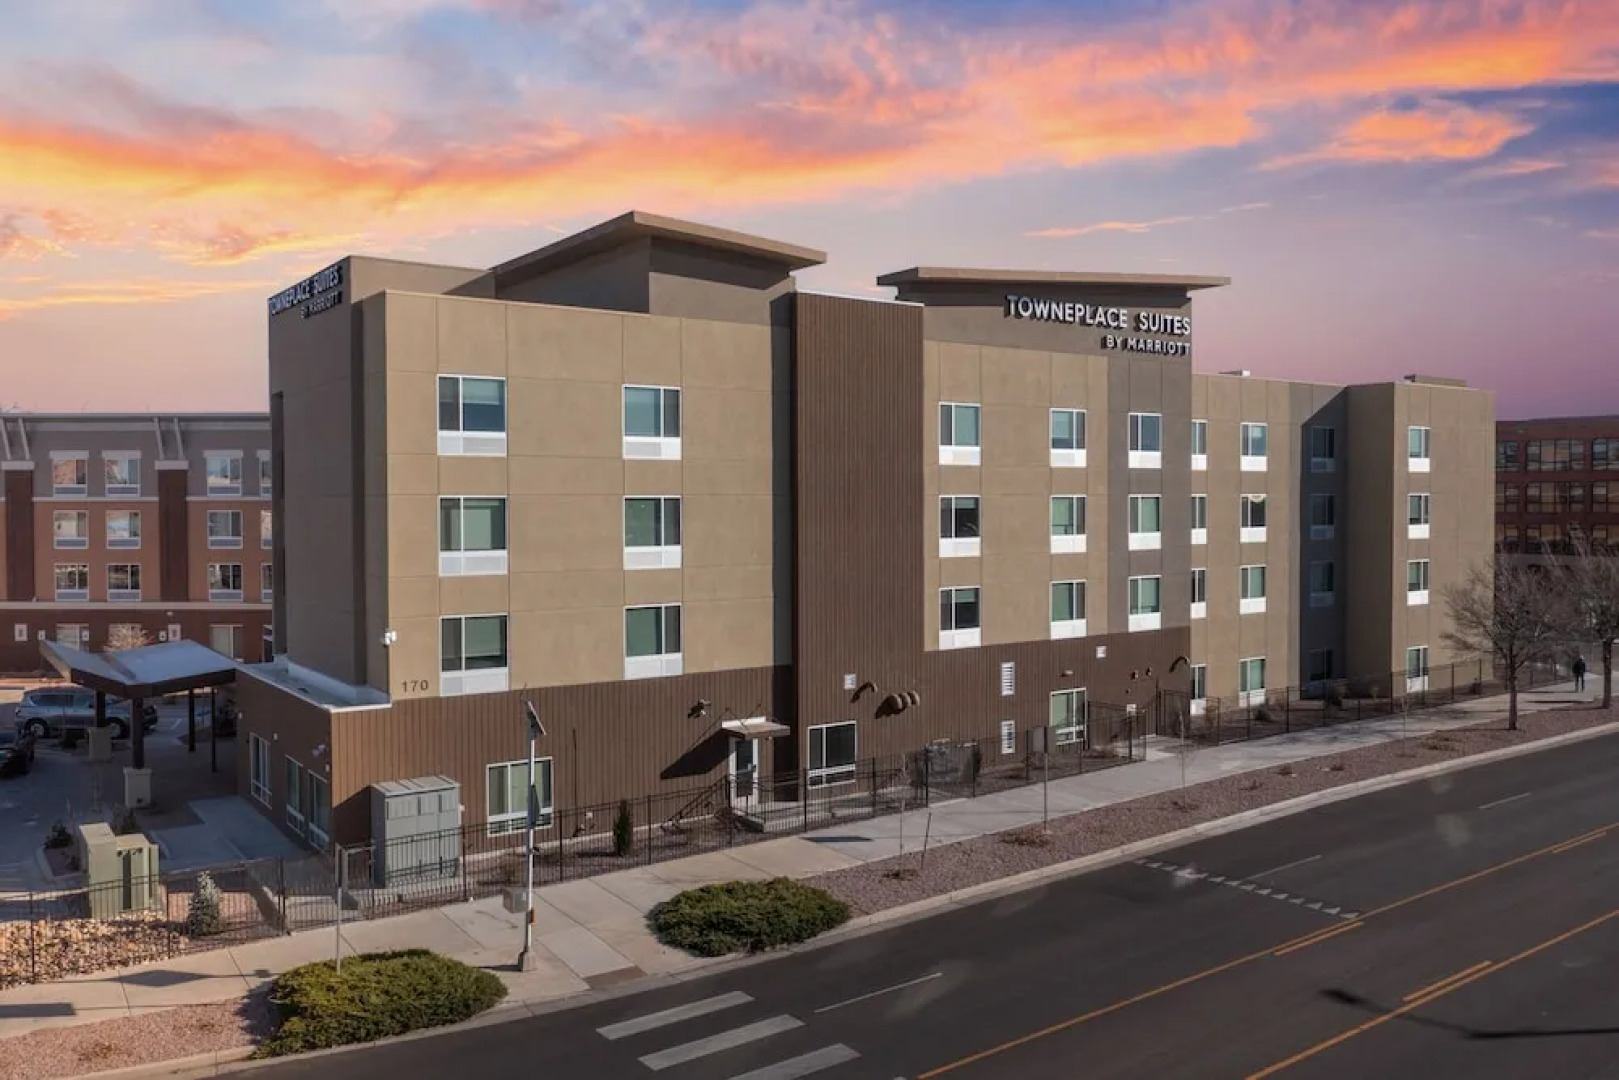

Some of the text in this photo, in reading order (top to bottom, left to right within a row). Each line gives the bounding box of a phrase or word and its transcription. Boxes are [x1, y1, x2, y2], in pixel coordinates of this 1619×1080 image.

[313, 264, 340, 294] SUITES
[1006, 295, 1191, 336] TOWNEPLACE SUITES
[1106, 334, 1191, 356] BY MARRIOTT
[401, 679, 429, 693] 170
